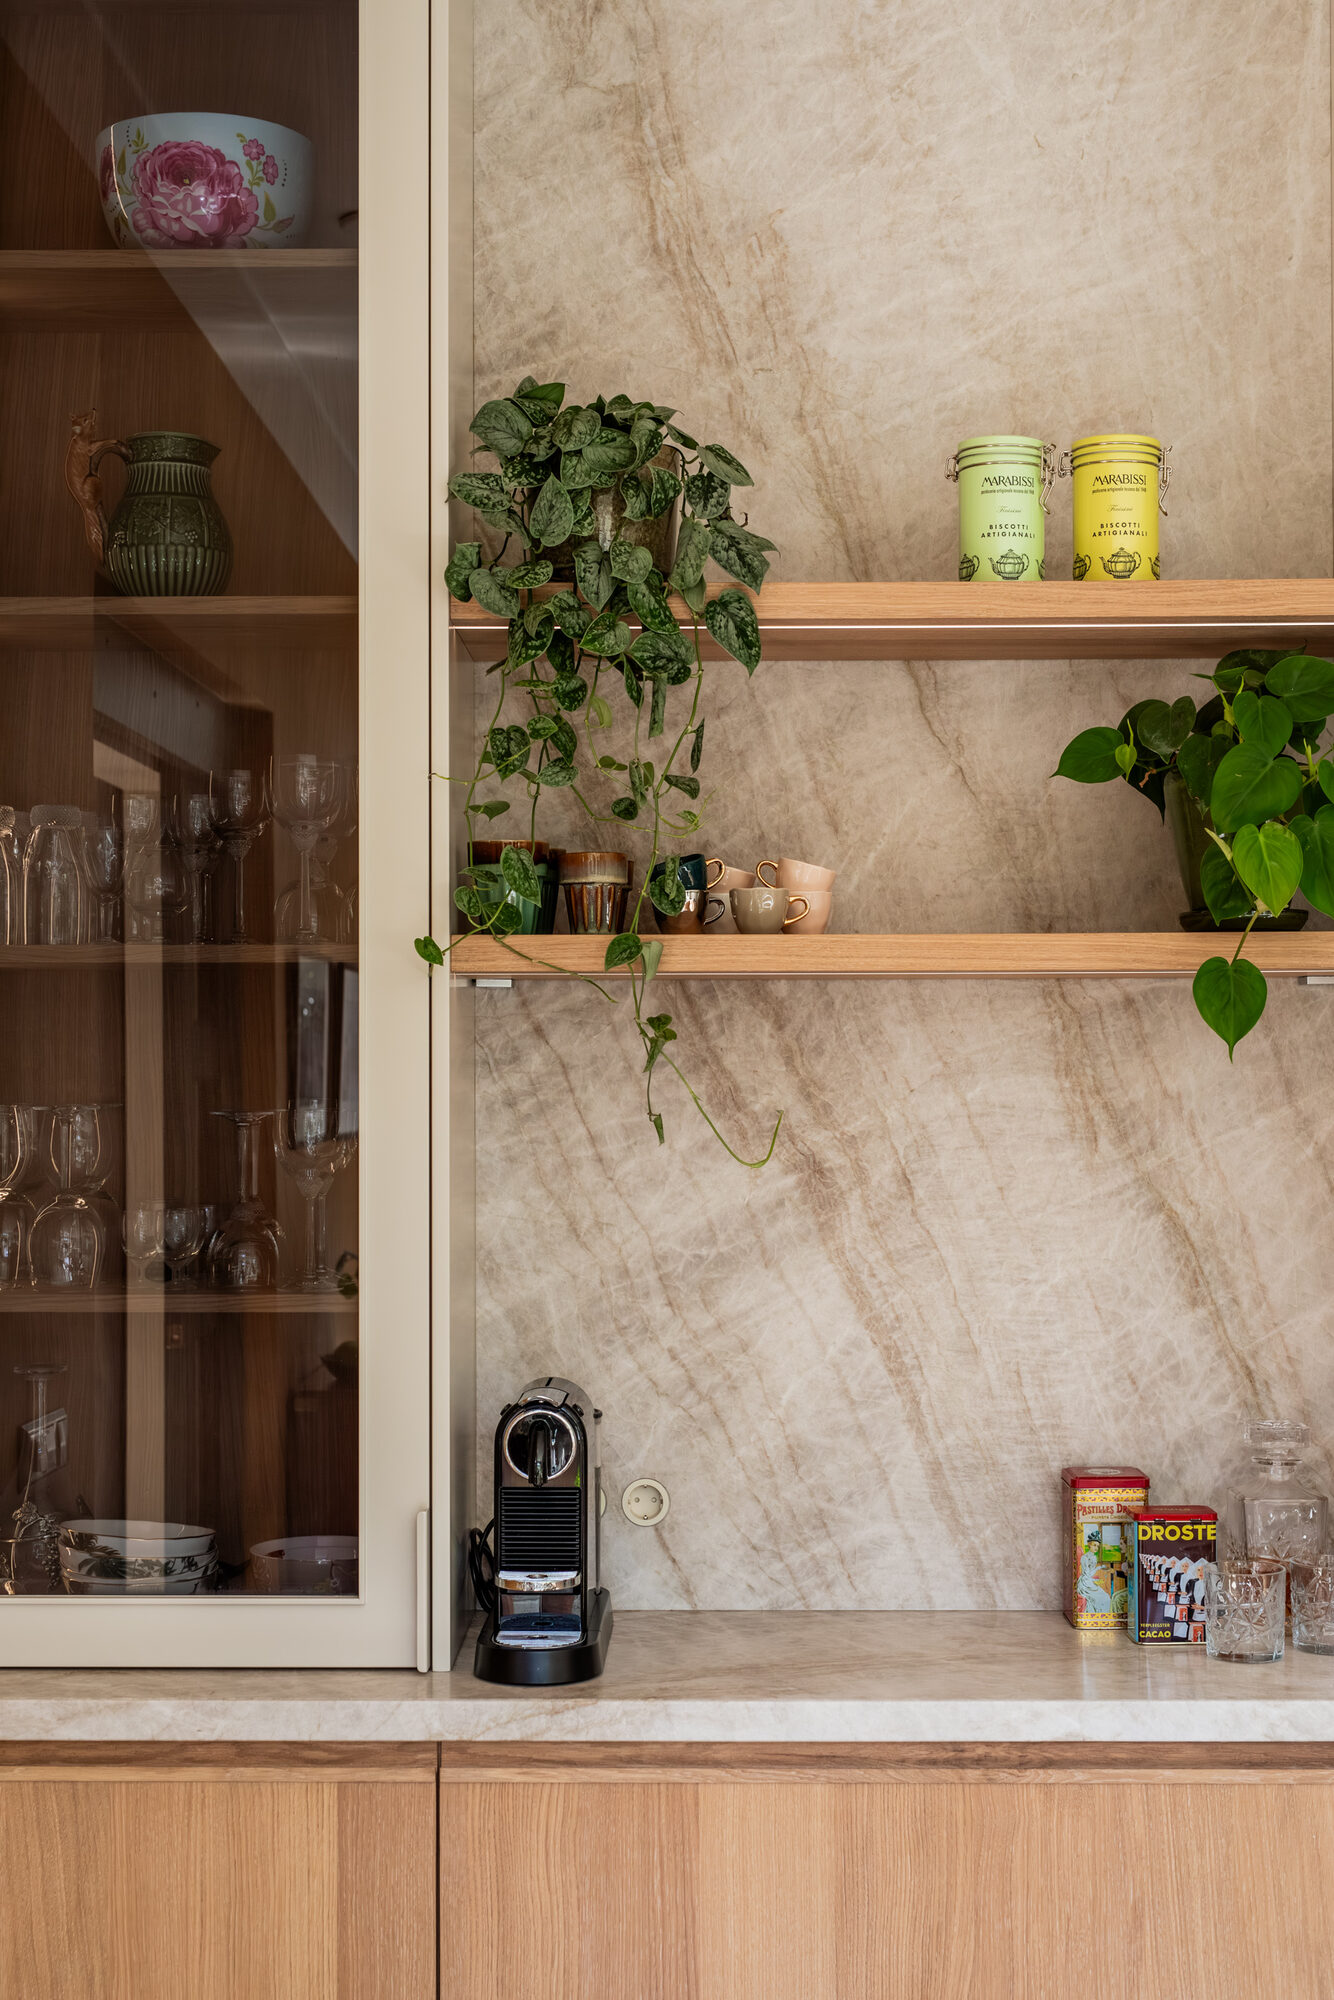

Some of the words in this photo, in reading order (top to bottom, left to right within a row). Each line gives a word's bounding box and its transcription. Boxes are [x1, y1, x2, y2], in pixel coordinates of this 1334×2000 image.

[981, 476, 1034, 488] MARABISSI
[1092, 474, 1147, 486] MARABISSI
[980, 531, 1035, 539] ARTIGIANALI
[1077, 1503, 1114, 1520] PASTILLES
[1138, 1524, 1217, 1541] DROSTE
[1139, 1630, 1172, 1638] CACAO
